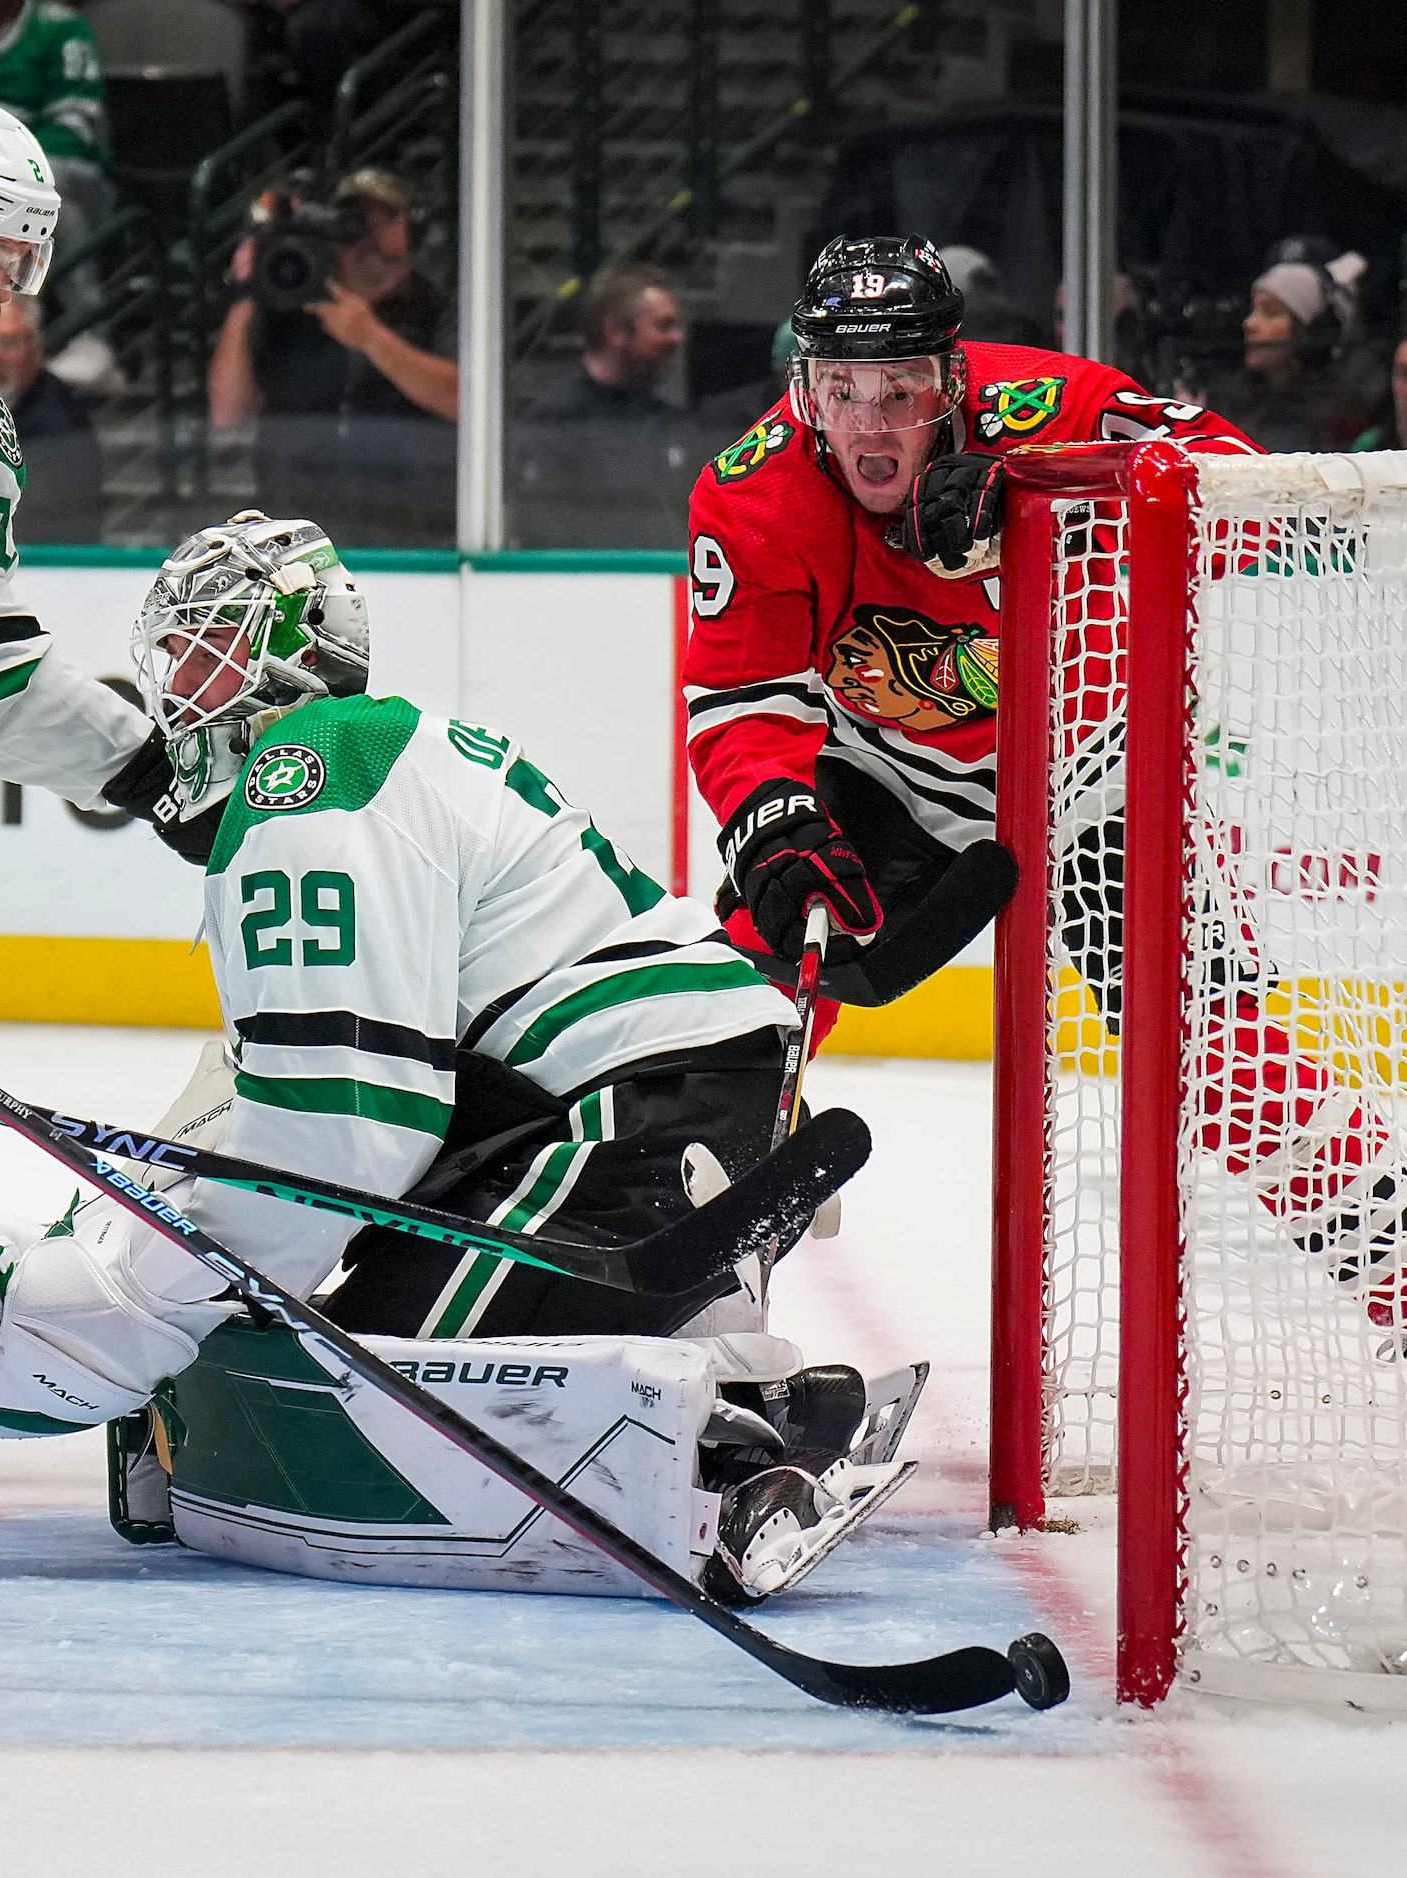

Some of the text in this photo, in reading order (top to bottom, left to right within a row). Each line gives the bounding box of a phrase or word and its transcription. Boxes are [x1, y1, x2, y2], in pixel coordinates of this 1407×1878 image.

[27, 158, 45, 183] 2
[850, 273, 886, 299] 19
[248, 749, 315, 788] DALLAS
[254, 780, 317, 805] STARS
[724, 794, 818, 898] AUER
[240, 869, 356, 971] 29
[178, 1101, 234, 1139] MACH
[50, 1111, 199, 1171] SYNC
[106, 1169, 200, 1237] BAUER
[32, 1374, 100, 1410] MACH
[388, 1360, 570, 1388] BAUER
[631, 1380, 661, 1401] MACH
